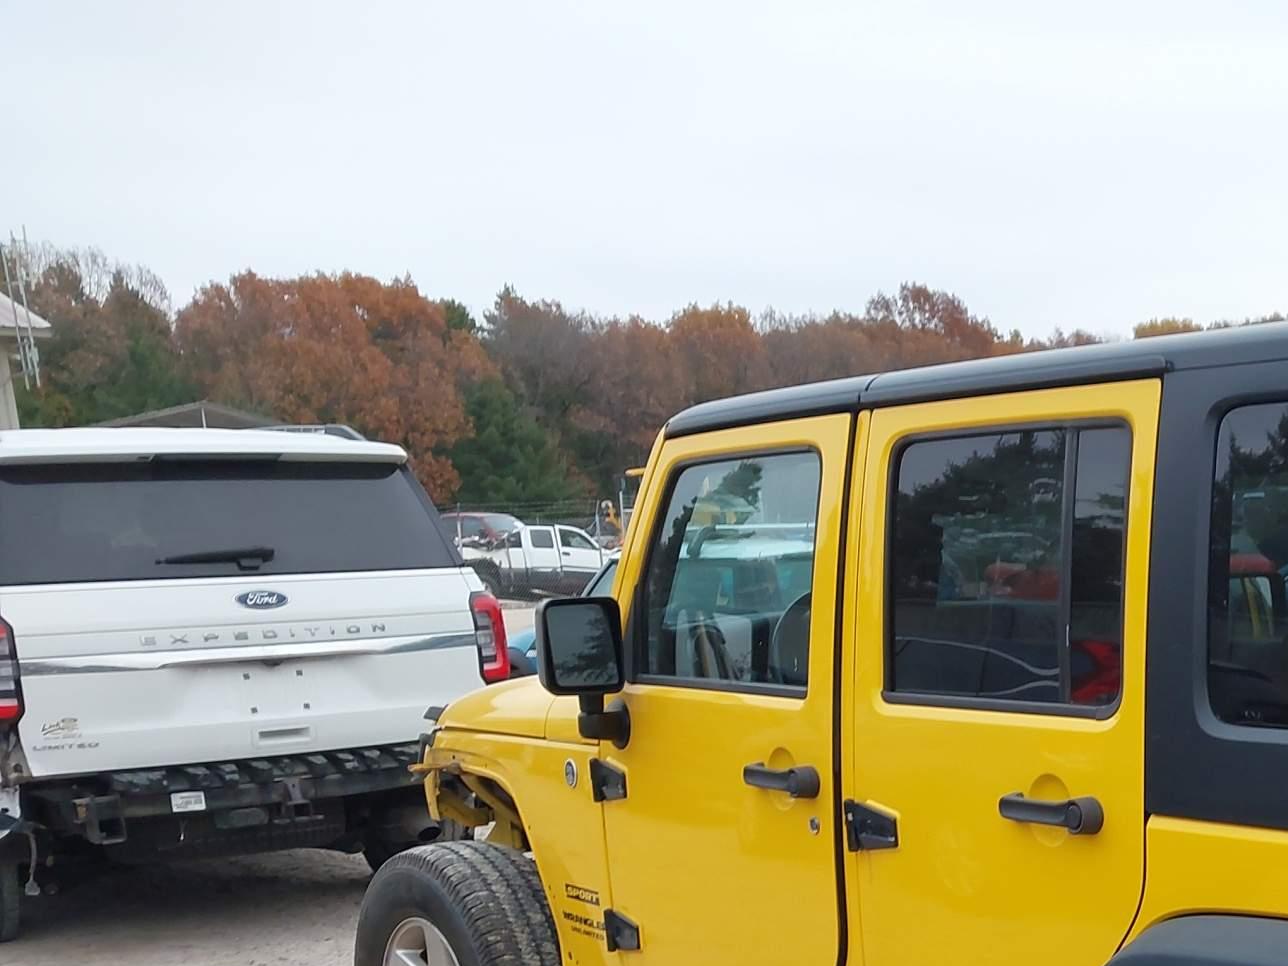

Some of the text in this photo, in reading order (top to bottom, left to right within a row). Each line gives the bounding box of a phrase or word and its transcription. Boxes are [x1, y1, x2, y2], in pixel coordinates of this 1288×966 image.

[246, 592, 279, 605] Ford
[139, 622, 387, 647] EXPEDITION
[31, 741, 100, 753] LIMITED
[567, 885, 598, 902] SPORT
